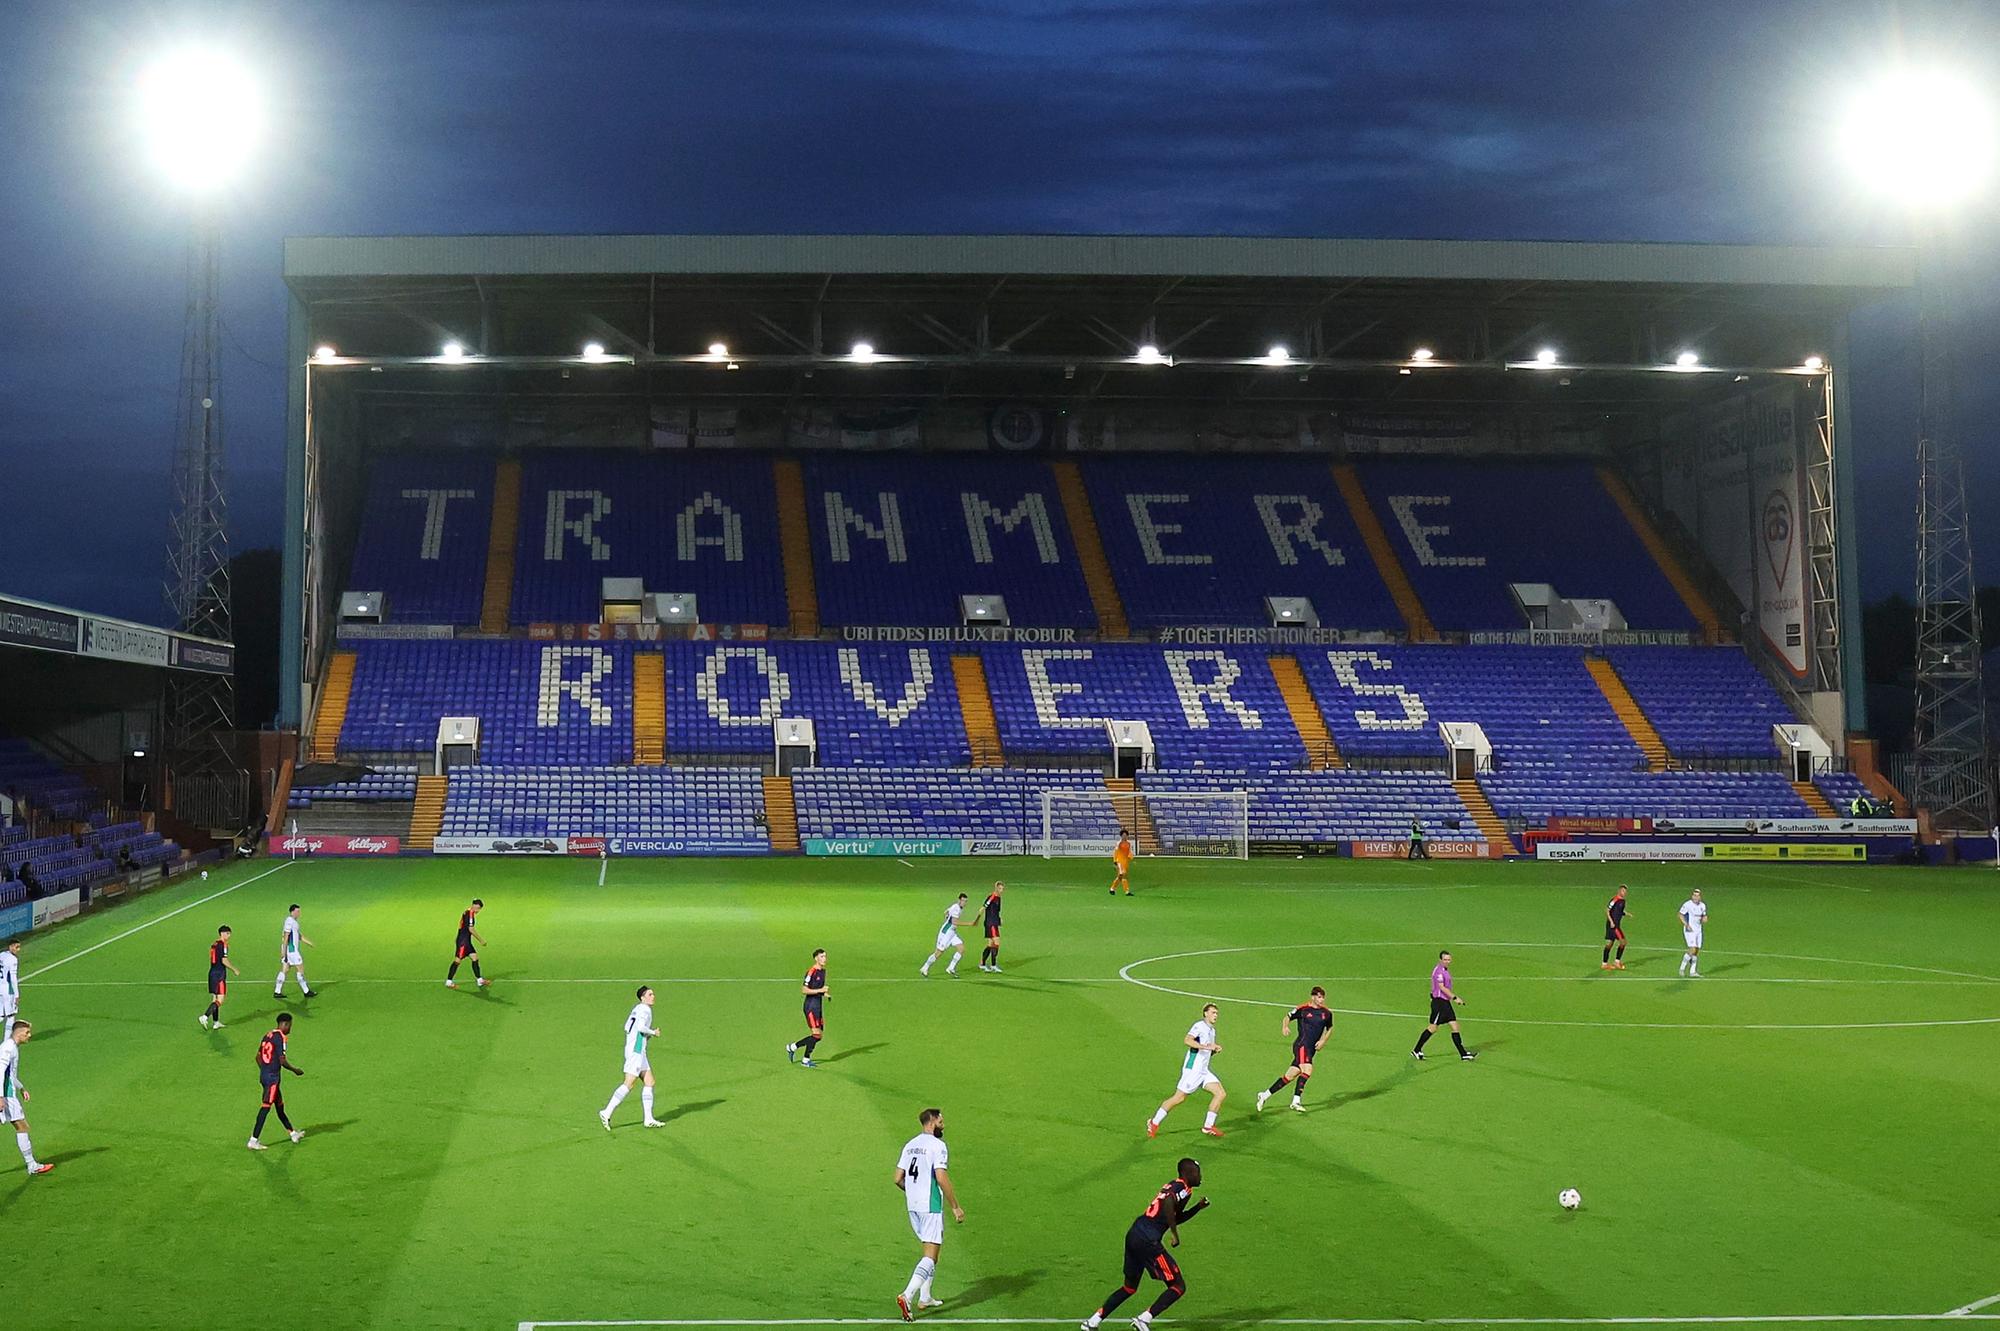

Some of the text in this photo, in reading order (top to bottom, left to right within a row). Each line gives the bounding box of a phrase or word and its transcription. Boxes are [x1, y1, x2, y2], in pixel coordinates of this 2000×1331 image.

[402, 488, 1486, 568] TRANMERE
[844, 626, 1075, 643] UBI FIDES IBI LUX ET ROBUR
[1160, 627, 1340, 645] #TOGETHERSTRONGER
[1488, 632, 1505, 646] THE
[1534, 632, 1551, 646] FOR
[1553, 632, 1570, 646] THE
[537, 647, 1429, 731] ROVERS
[348, 837, 389, 853] Kellogg's
[626, 842, 684, 851] EVERCLAD
[825, 841, 868, 854] Vertu
[893, 841, 936, 854] Vertu
[1429, 843, 1473, 853] DESIGN
[908, 1157, 919, 1183] 4
